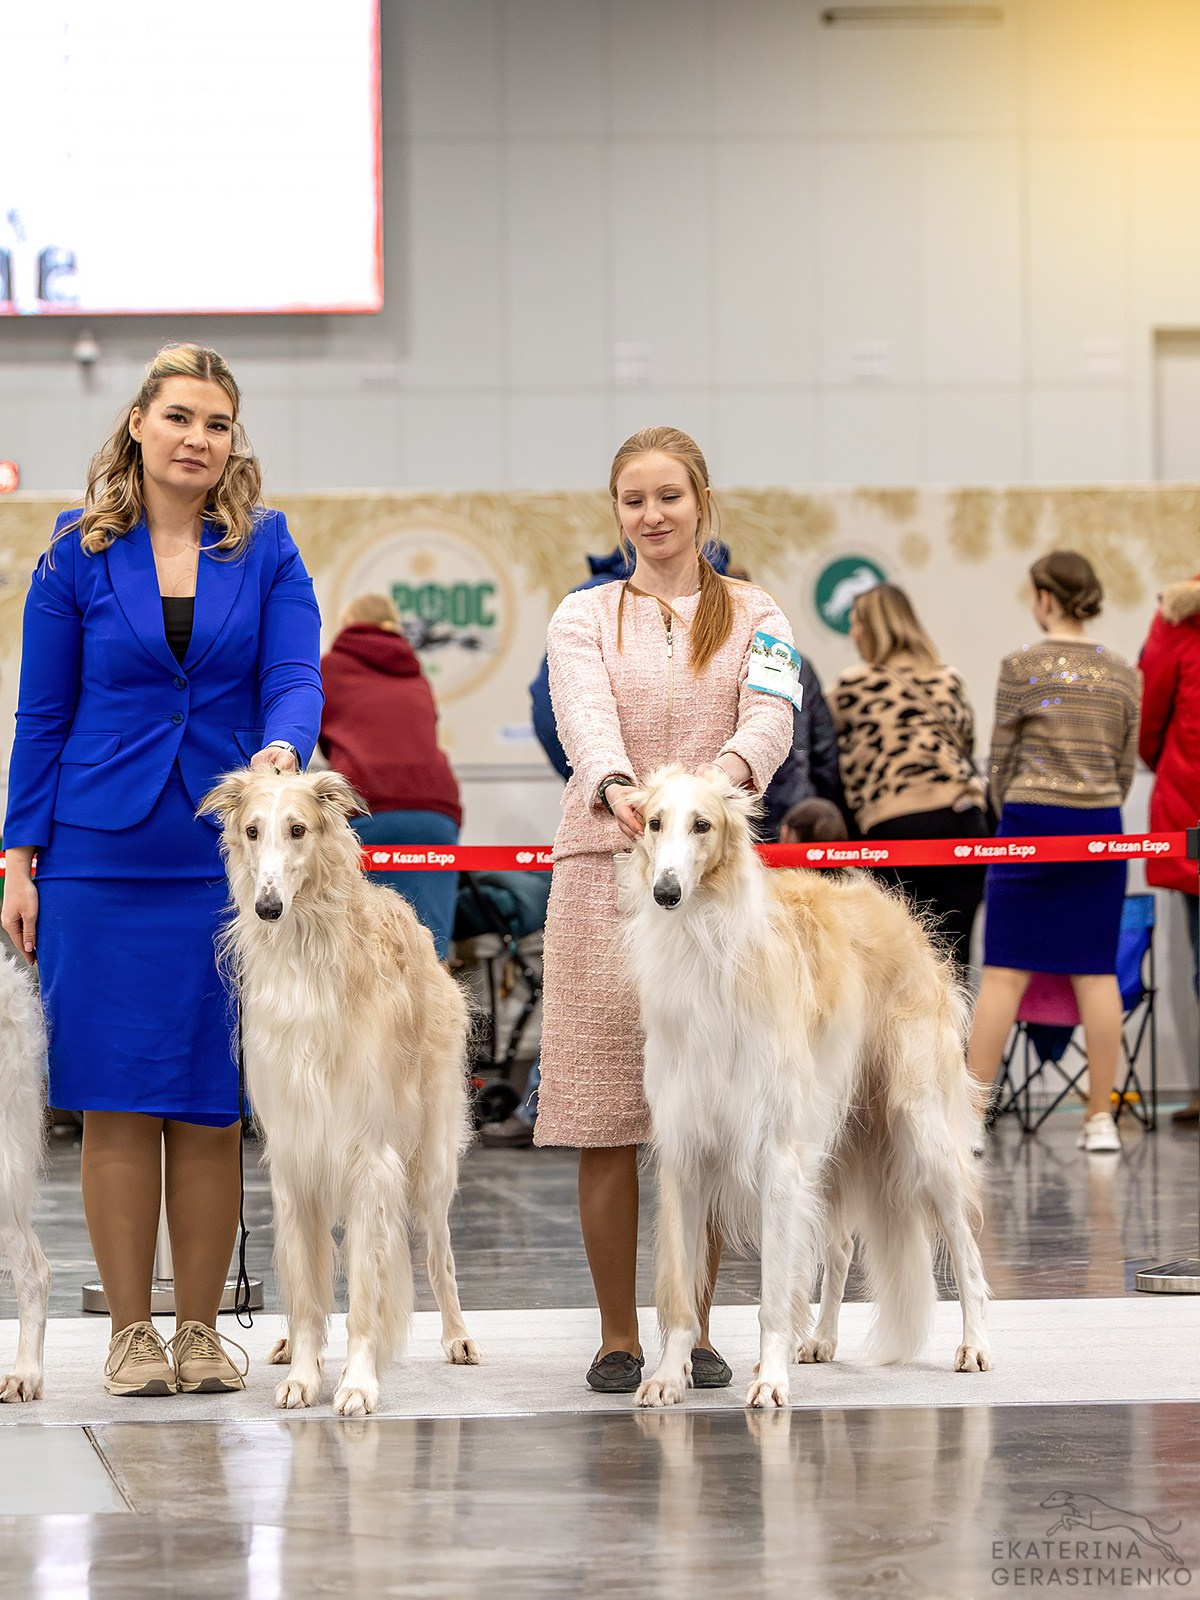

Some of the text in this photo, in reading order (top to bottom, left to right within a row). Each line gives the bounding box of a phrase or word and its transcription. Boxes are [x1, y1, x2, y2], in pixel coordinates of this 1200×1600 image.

[974, 844, 1036, 858] Kazan Expo
[1108, 840, 1170, 854] Kazan Expo
[392, 852, 455, 866] Kazan Expo
[826, 848, 889, 862] Kazan Expo
